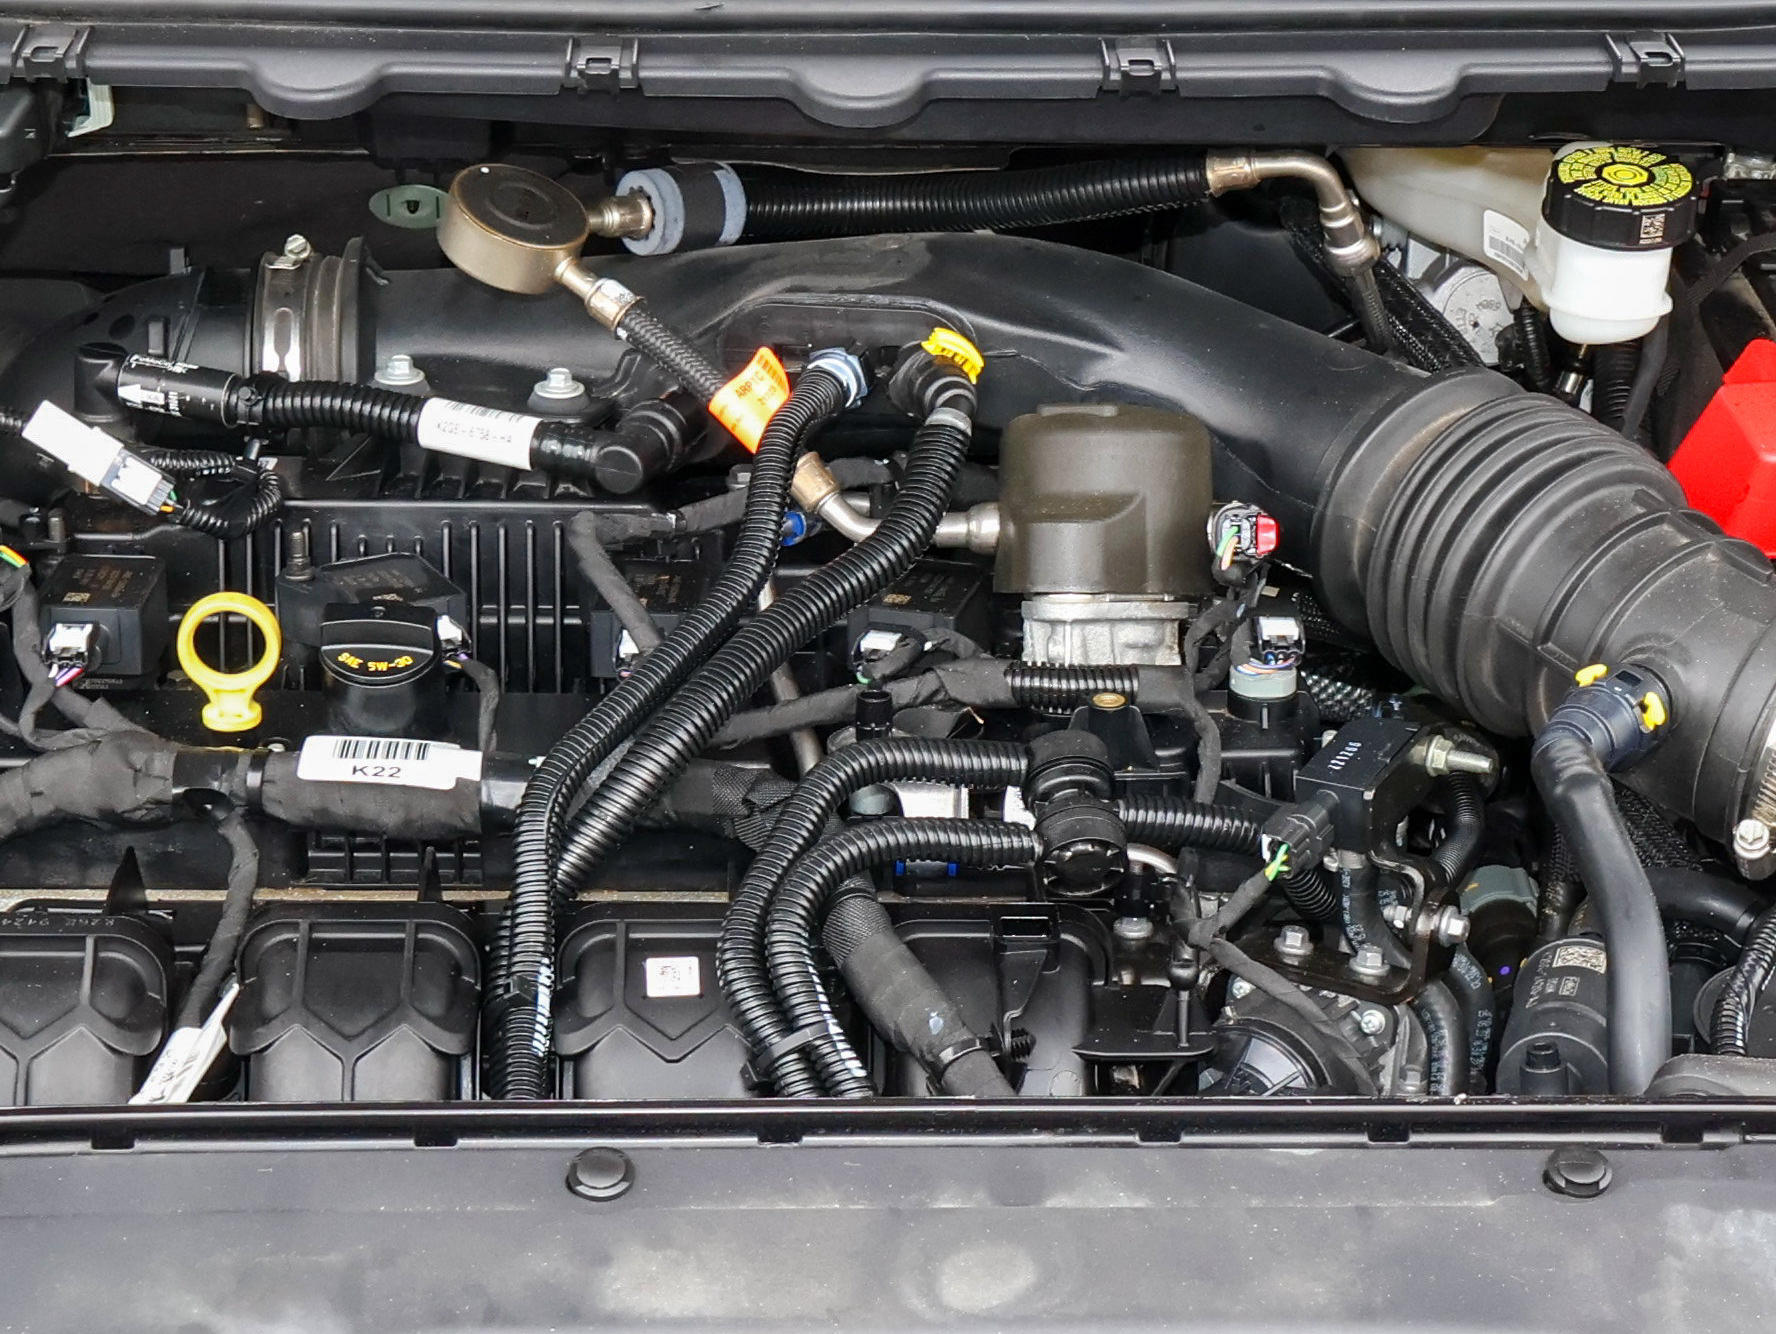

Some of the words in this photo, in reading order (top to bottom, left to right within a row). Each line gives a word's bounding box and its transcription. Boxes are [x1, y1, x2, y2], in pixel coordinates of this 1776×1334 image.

[336, 650, 366, 674] SAE
[367, 651, 415, 674] 5W-30
[351, 760, 404, 780] K22
